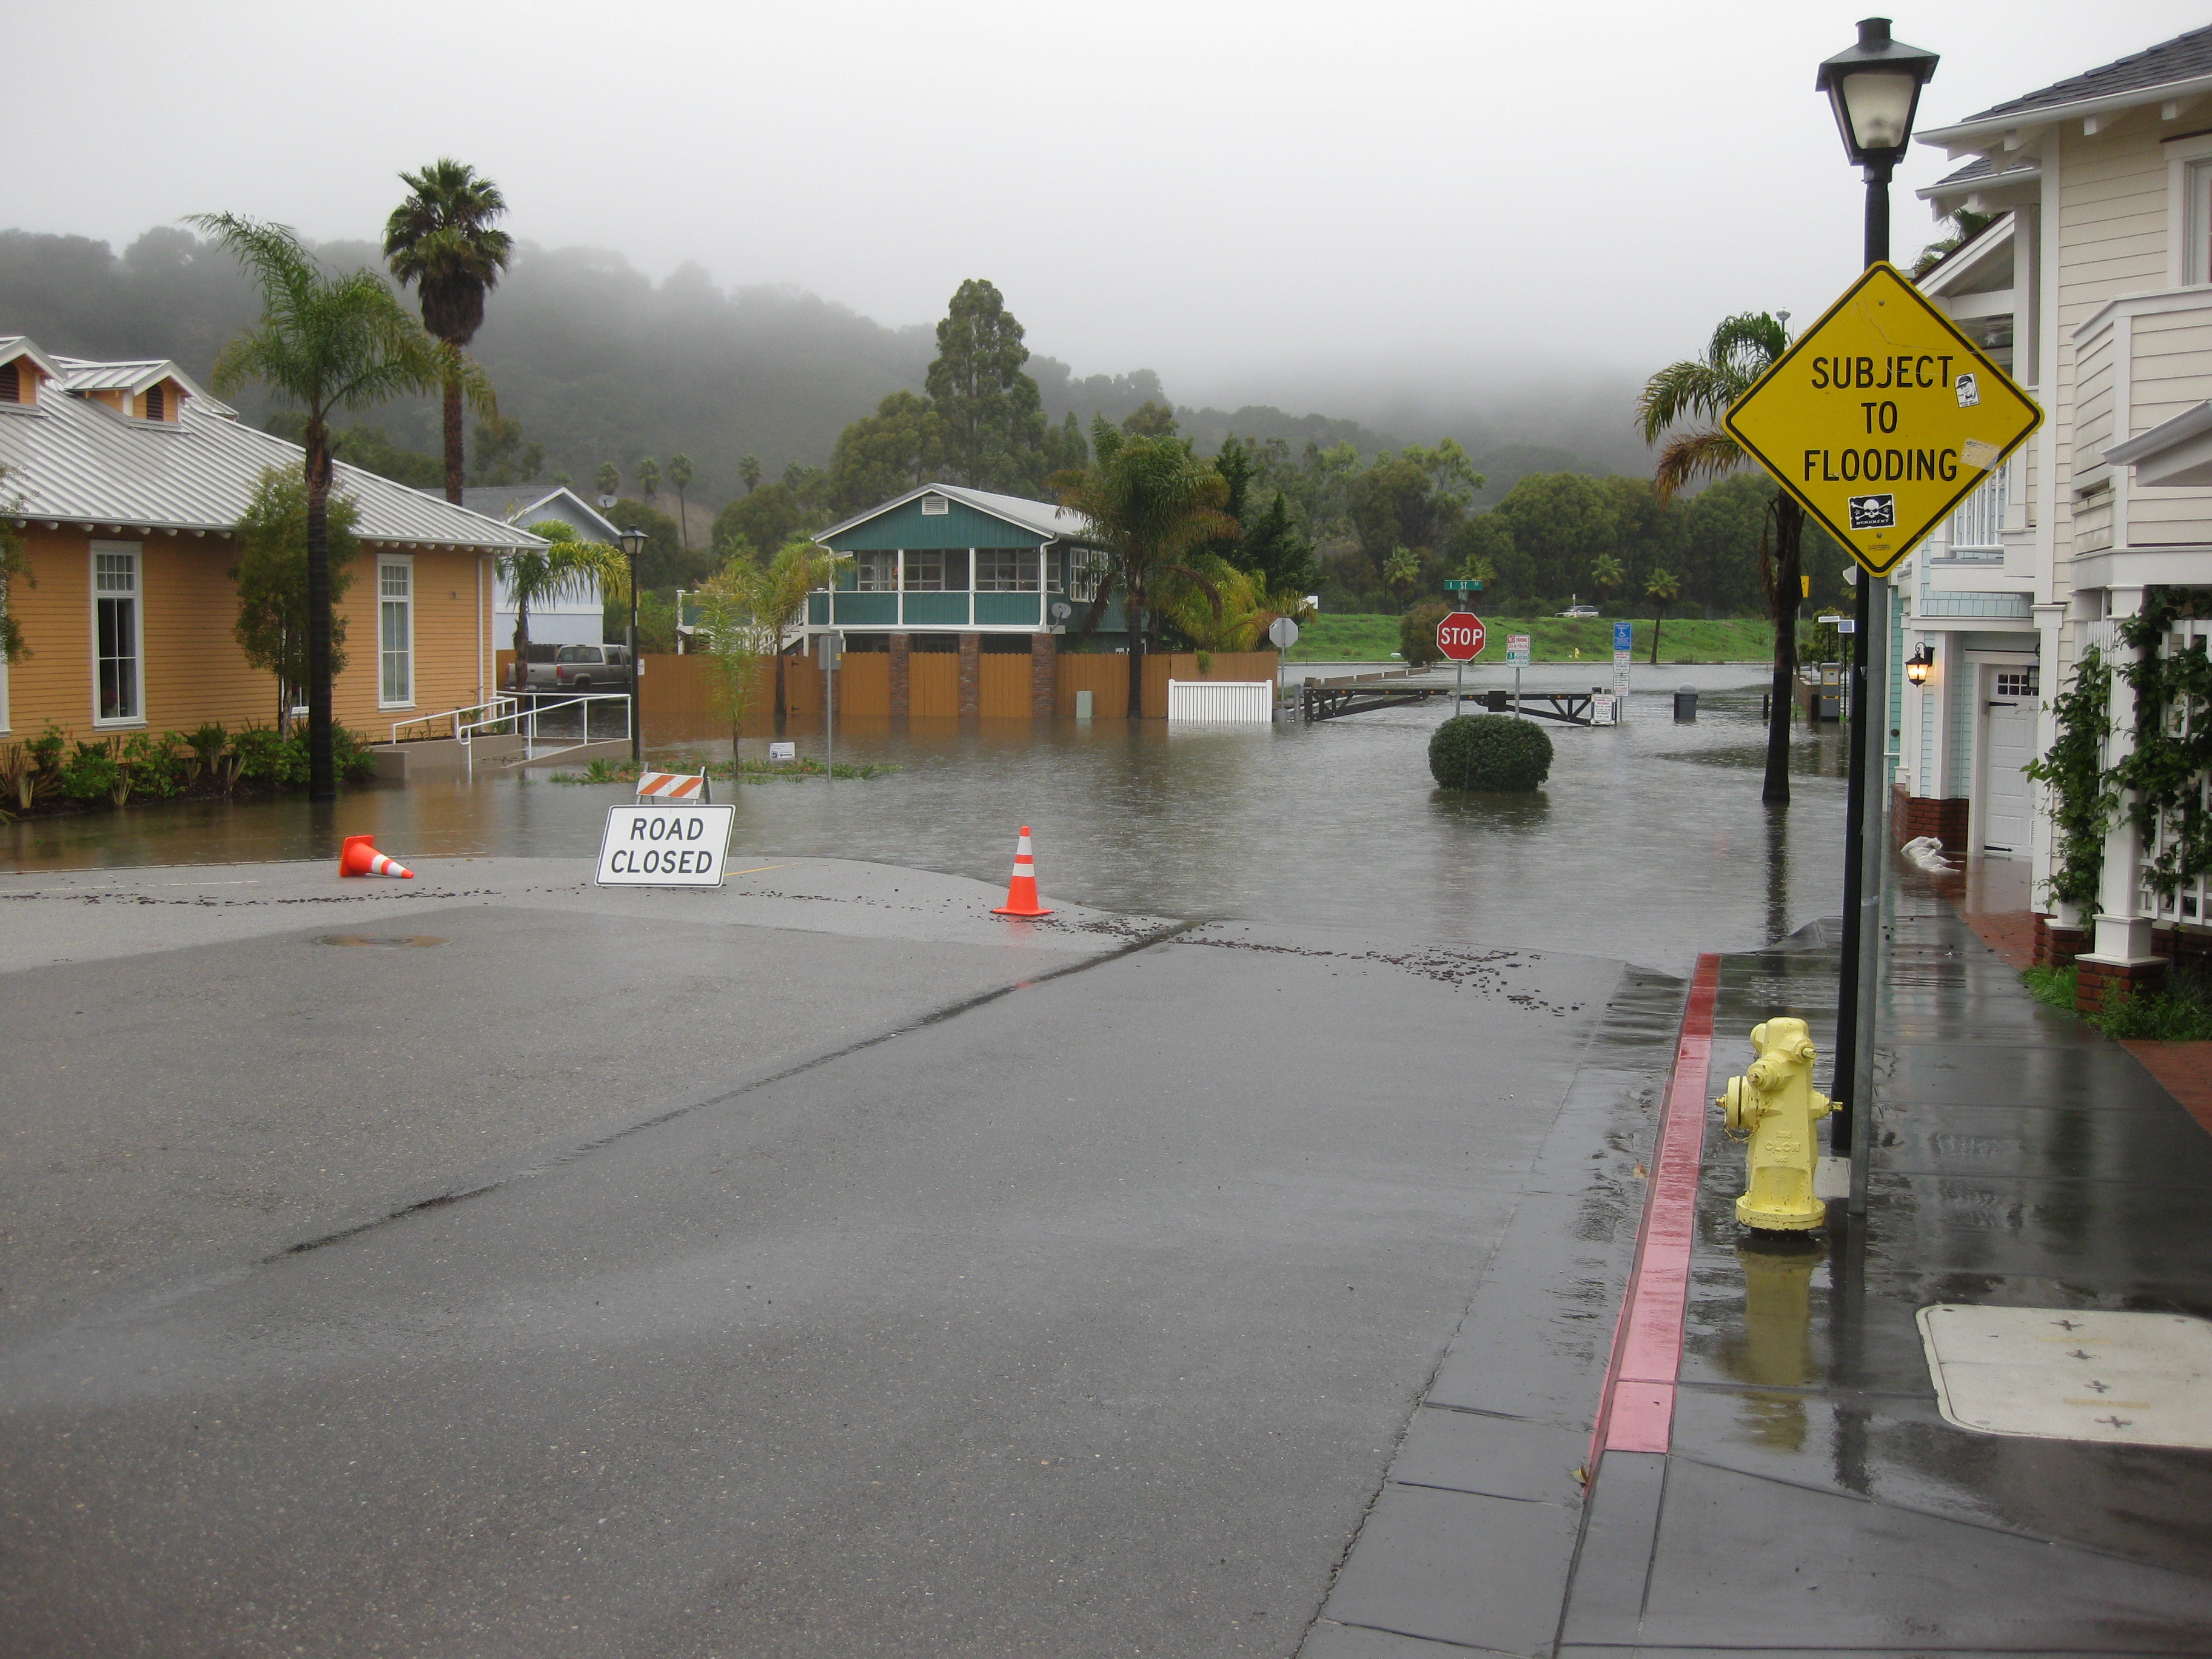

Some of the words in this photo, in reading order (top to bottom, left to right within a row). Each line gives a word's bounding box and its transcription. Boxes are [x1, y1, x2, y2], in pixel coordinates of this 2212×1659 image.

[1811, 355, 1953, 389] SUBJECT
[1861, 401, 1898, 434] TO
[1804, 448, 1957, 481] FLOODING
[1441, 627, 1483, 646] STOP
[630, 817, 704, 840] ROAD
[611, 850, 712, 874] CLOSED
